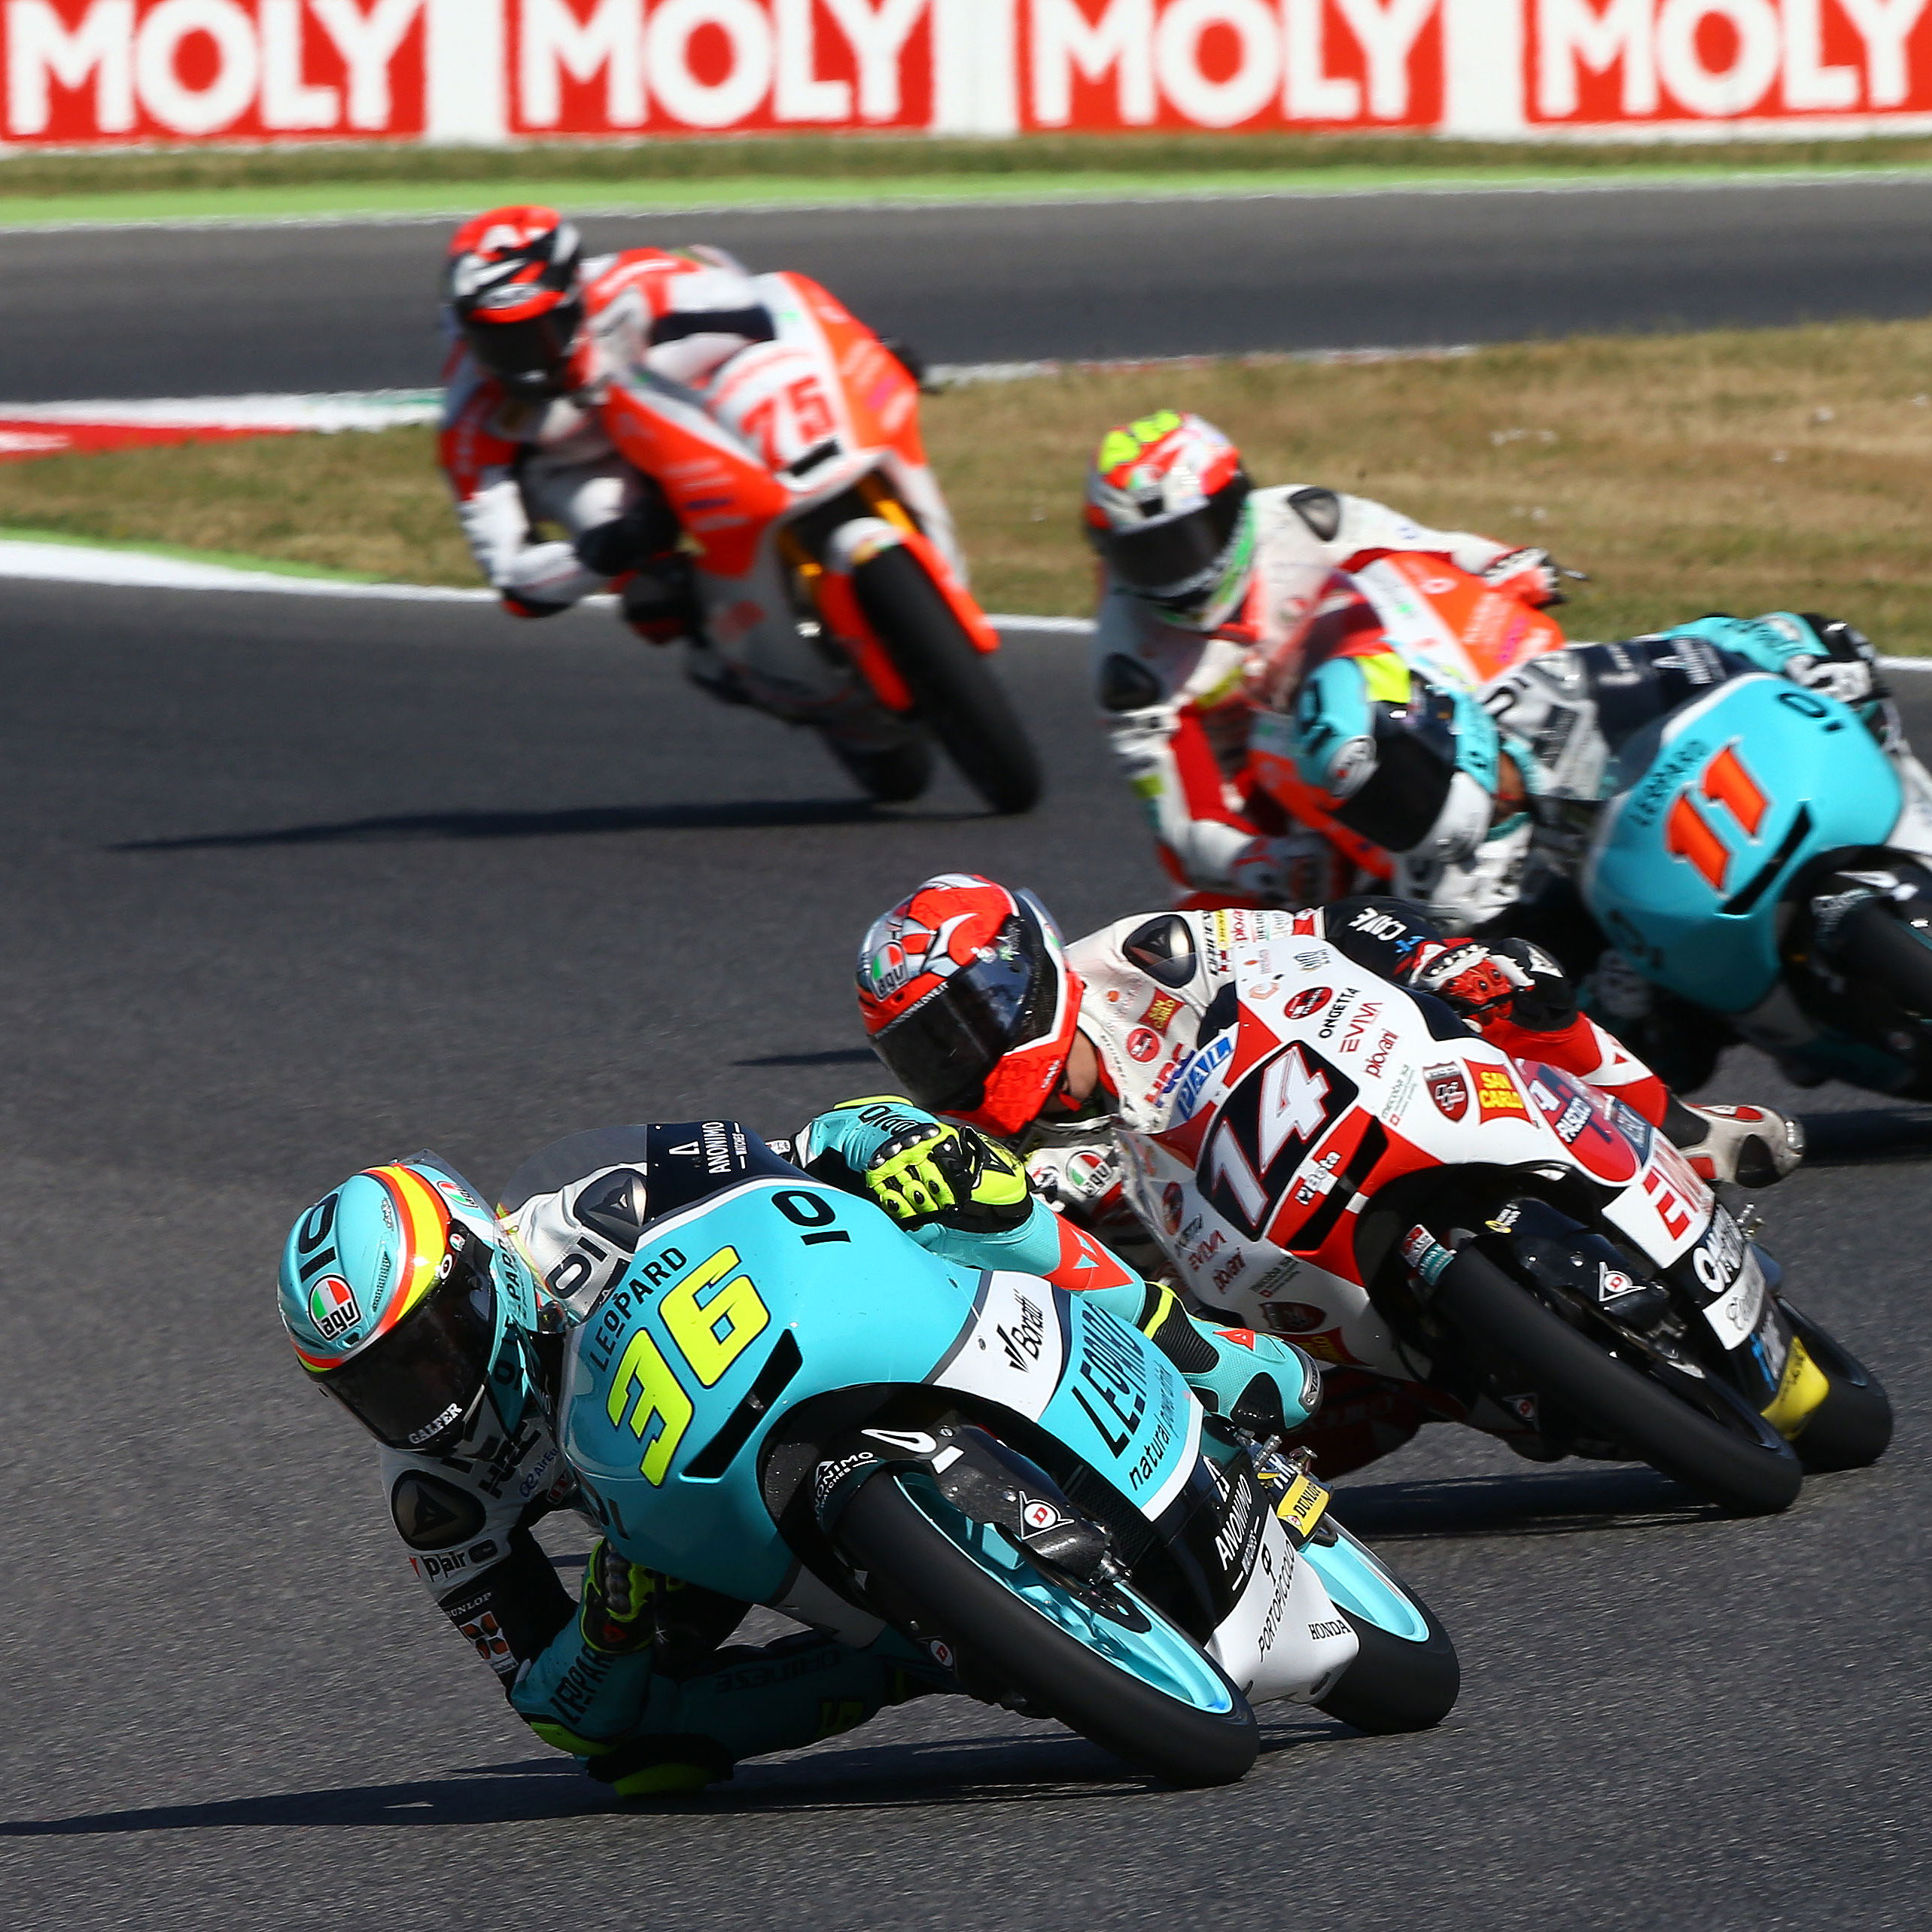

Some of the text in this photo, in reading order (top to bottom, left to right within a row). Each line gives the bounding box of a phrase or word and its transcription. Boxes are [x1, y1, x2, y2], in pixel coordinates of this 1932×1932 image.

[6, 0, 420, 134] MOLY
[519, 0, 926, 129] MOLY
[1030, 0, 1436, 126] MOLY
[1535, 0, 1932, 118] MOLY
[740, 376, 835, 473] 75
[1665, 738, 1770, 900] 11
[1318, 987, 1361, 1039] ONGETTA
[1337, 1001, 1383, 1053] EVIVA
[701, 1121, 732, 1174] ANONIMO
[1210, 1041, 1331, 1230] 14
[320, 1301, 357, 1340] agv
[589, 1246, 687, 1372] LEOPARD
[607, 1245, 771, 1487] 36
[1071, 1300, 1147, 1459] LEOPARD
[407, 1402, 464, 1446] GALFER
[1214, 1473, 1252, 1571] ANONIMO
[1292, 1482, 1322, 1519] DUNLOP
[1258, 1538, 1296, 1663] PORTOPICCOLO
[1310, 1620, 1352, 1641] HONDA
[549, 1650, 616, 1727] LEOPAR
